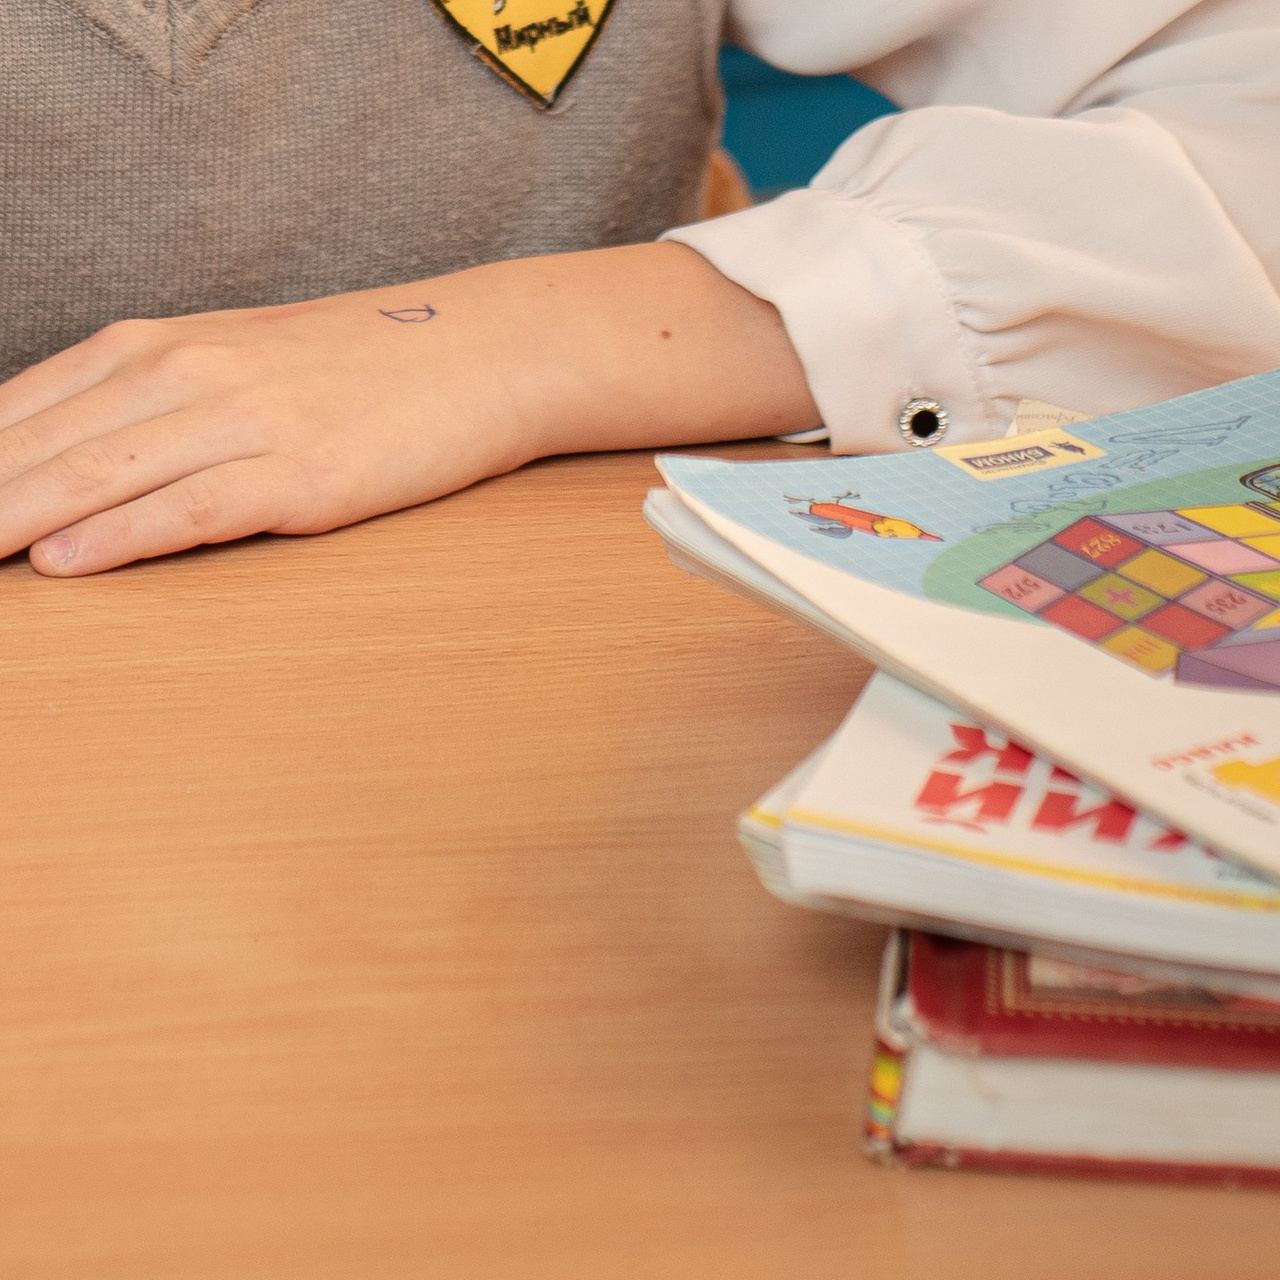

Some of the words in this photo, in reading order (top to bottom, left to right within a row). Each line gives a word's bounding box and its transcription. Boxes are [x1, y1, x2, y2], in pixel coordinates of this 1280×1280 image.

[493, 0, 594, 55] Мирный
[970, 448, 1045, 469] БИНОМ
[1081, 533, 1122, 559] 827
[1004, 578, 1041, 600] 572
[1205, 591, 1246, 614] 235
